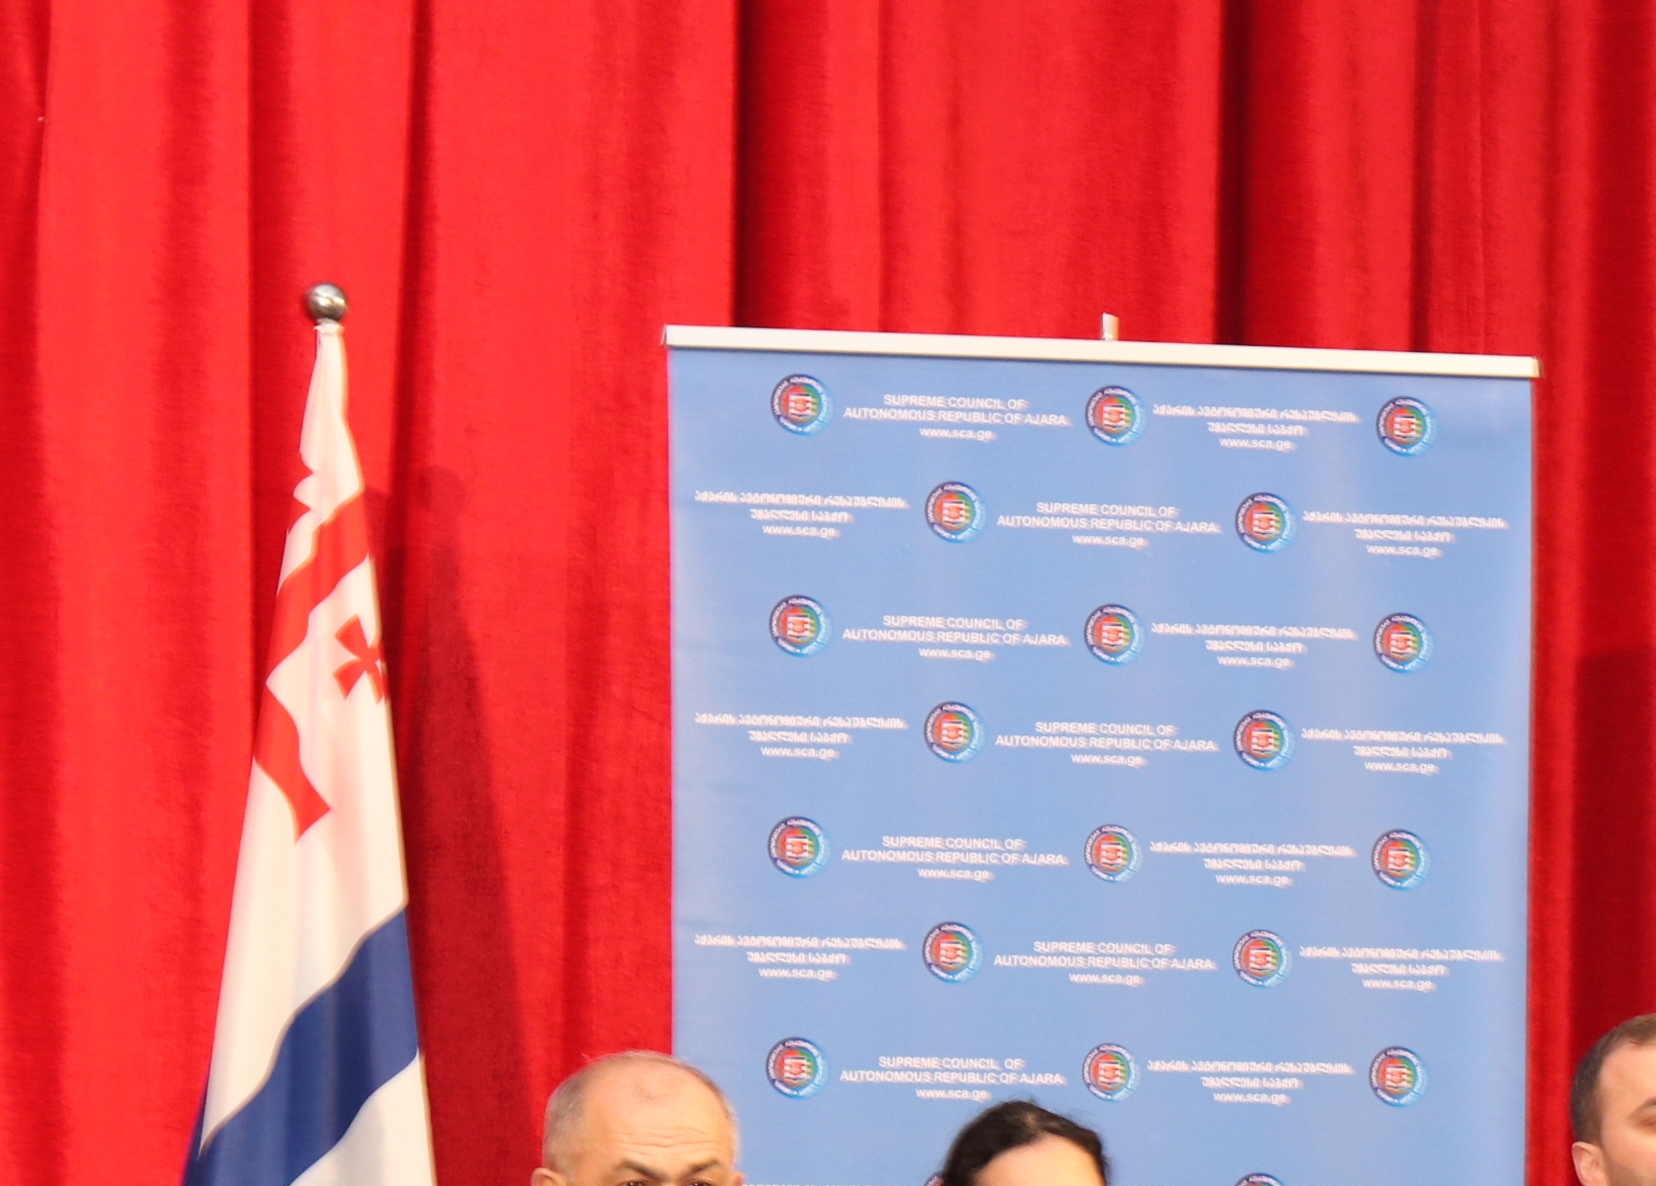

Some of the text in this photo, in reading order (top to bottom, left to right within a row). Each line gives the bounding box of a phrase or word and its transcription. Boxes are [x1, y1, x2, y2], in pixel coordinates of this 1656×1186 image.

[883, 394, 1028, 411] SUPREME COUNCIL OF
[844, 407, 1070, 427] AUTONOMOUS REPUBLIC OF AJARA
[919, 426, 996, 441] www.sca.ge
[1219, 437, 1295, 450] www.sca.ge
[1036, 502, 1179, 519] SUPREME COUNCIL OF
[763, 524, 839, 537] www.sca.ge
[997, 515, 1220, 534] AUTONOMOUS REPUBLIC OF AJARA
[1072, 533, 1149, 548] www.sca.ge
[1366, 544, 1442, 557] www.sca.ge
[882, 615, 1026, 631] SUPREME COUNCIL OF
[843, 628, 1069, 647] AUTONOMOUS REPUBLIC OF AJARA
[918, 646, 995, 661] www.sca.ge
[1218, 655, 1294, 668] www.sca.ge
[1034, 721, 1177, 737] SUPREME COUNCIL OF
[995, 734, 1219, 753] AUTONOMOUS REPUBLIC OF AJARA
[761, 745, 837, 758] www.sca.ge
[1070, 752, 1147, 767] www.sca.ge
[1363, 760, 1439, 773] www.sca.ge
[881, 835, 1025, 851] SUPREME COUNCIL OF
[842, 849, 1068, 867] AUTONOMOUS REPUBLIC OF AJARA
[916, 866, 993, 881] www.sca.ge
[1216, 873, 1292, 886] www.sca.ge
[1033, 941, 1175, 956] SUPREME COUNCIL OF
[994, 954, 1216, 971] AUTONOMOUS REPUBLIC OF AJARA
[759, 966, 835, 979] www.sca.ge
[1068, 971, 1145, 986] www.sca.ge
[1360, 977, 1436, 990] www.sca.ge
[878, 1056, 1025, 1070] SUPREME COUNCIL OF
[840, 1069, 1066, 1086] AUTONOMOUS REPUBLIC OF AJARA
[914, 1086, 991, 1101] www.sca.ge
[1214, 1091, 1290, 1104] www.sca.ge
